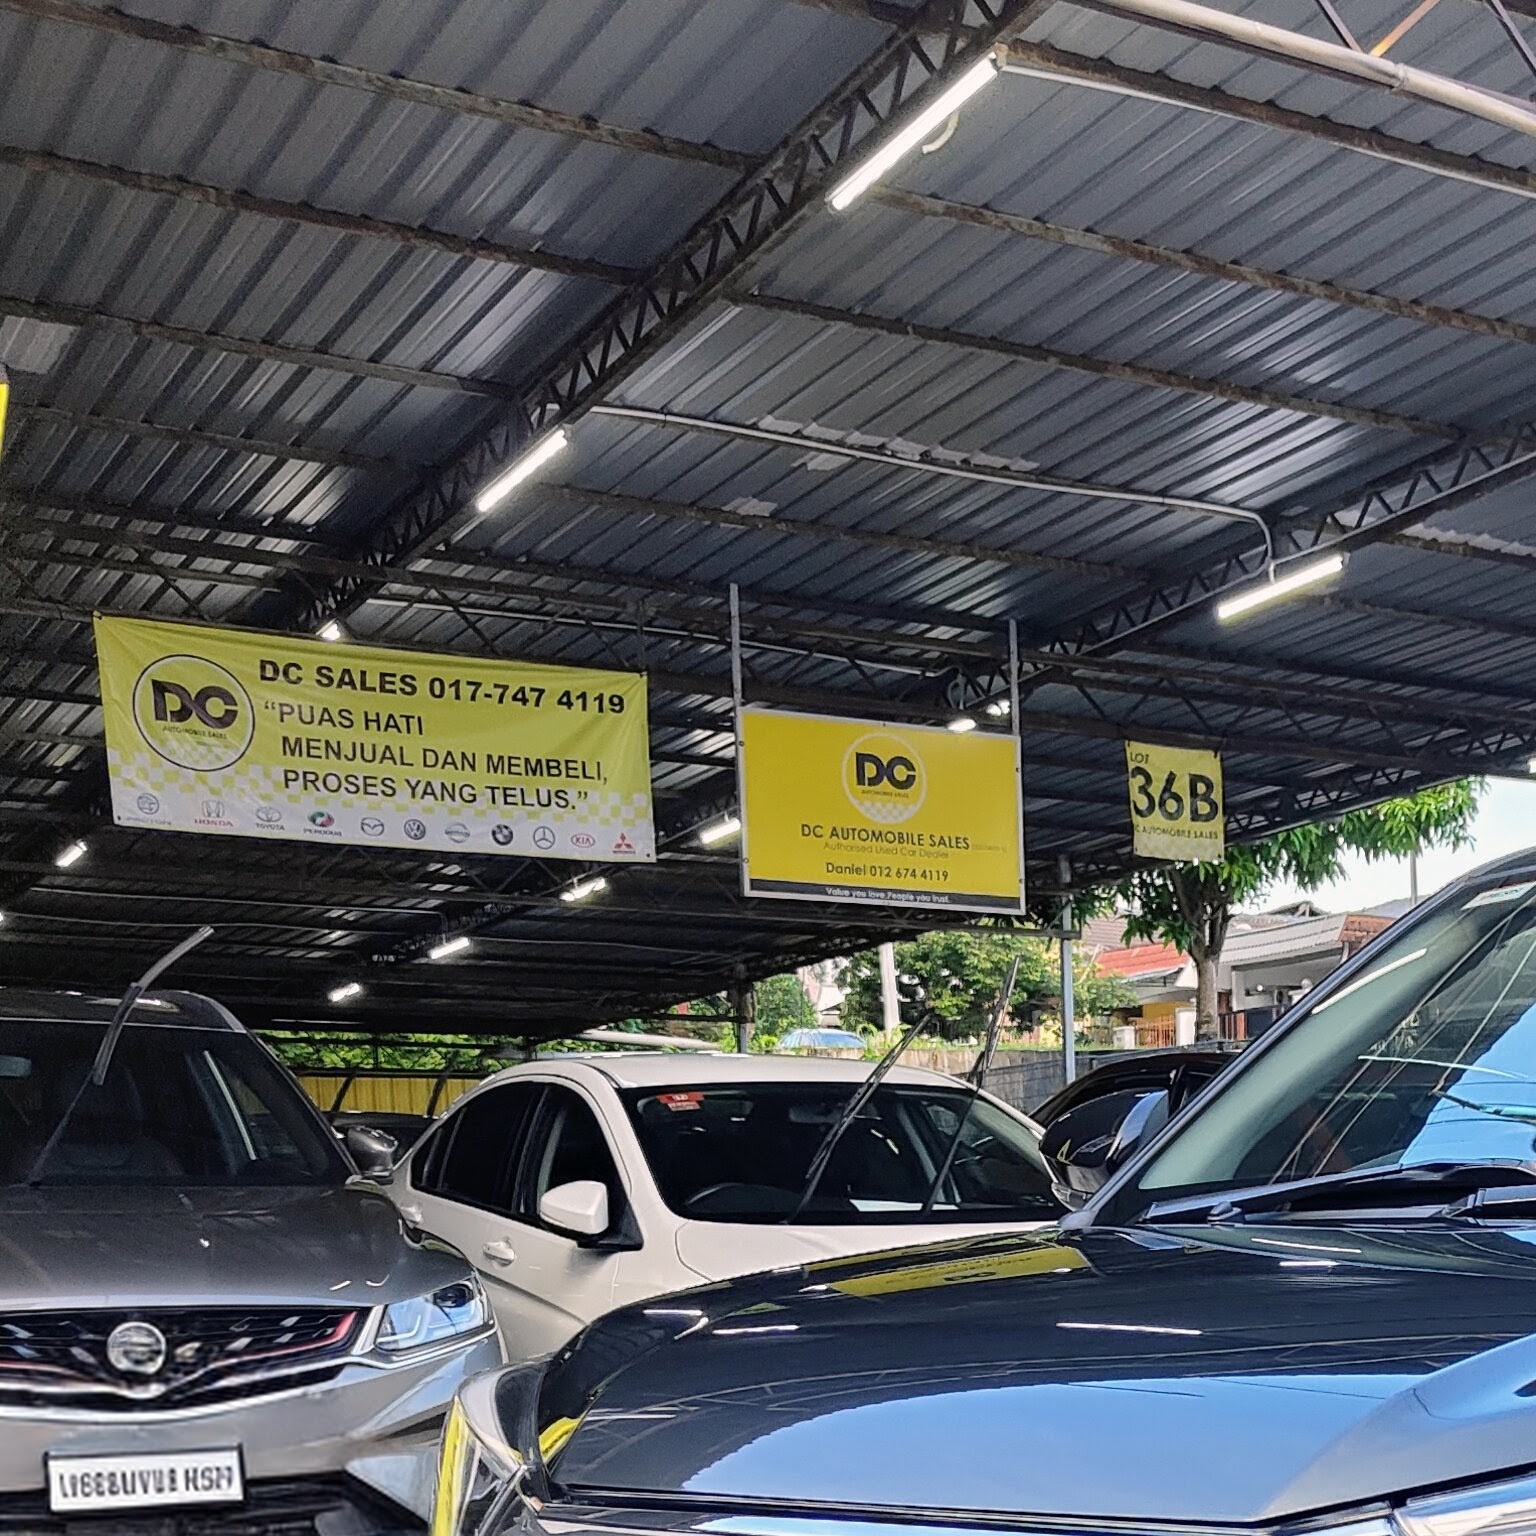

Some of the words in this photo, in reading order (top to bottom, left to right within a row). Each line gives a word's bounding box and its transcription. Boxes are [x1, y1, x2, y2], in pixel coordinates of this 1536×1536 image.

[260, 659, 303, 685] DC
[315, 665, 418, 696] SALES
[428, 677, 546, 708] 017-747
[557, 690, 625, 714] 4119
[151, 678, 238, 729] DC
[363, 710, 424, 736] HATI
[282, 736, 414, 767] MENJUAL
[422, 748, 476, 773] DAN
[486, 754, 608, 785] MEMBELI,
[855, 752, 916, 790] DC
[1130, 752, 1149, 764] LOT
[283, 769, 397, 798] PROSES
[404, 778, 478, 804] YANG
[1131, 766, 1219, 823] 36B
[194, 818, 235, 829] HONDA
[255, 822, 285, 832] TOYOTA
[1142, 826, 1191, 838] AUTOMOBILE
[1194, 830, 1219, 840] SALES
[574, 835, 592, 845] KIA
[801, 824, 824, 838] DC
[829, 826, 925, 846] AUTOMOBILE
[929, 835, 970, 850] SALES
[875, 845, 898, 856] Used
[900, 847, 918, 857] Car
[919, 849, 950, 859] Dealer
[826, 862, 866, 876] Daniel
[869, 865, 892, 878] 012
[895, 868, 917, 880] 674
[920, 870, 949, 882] 4119
